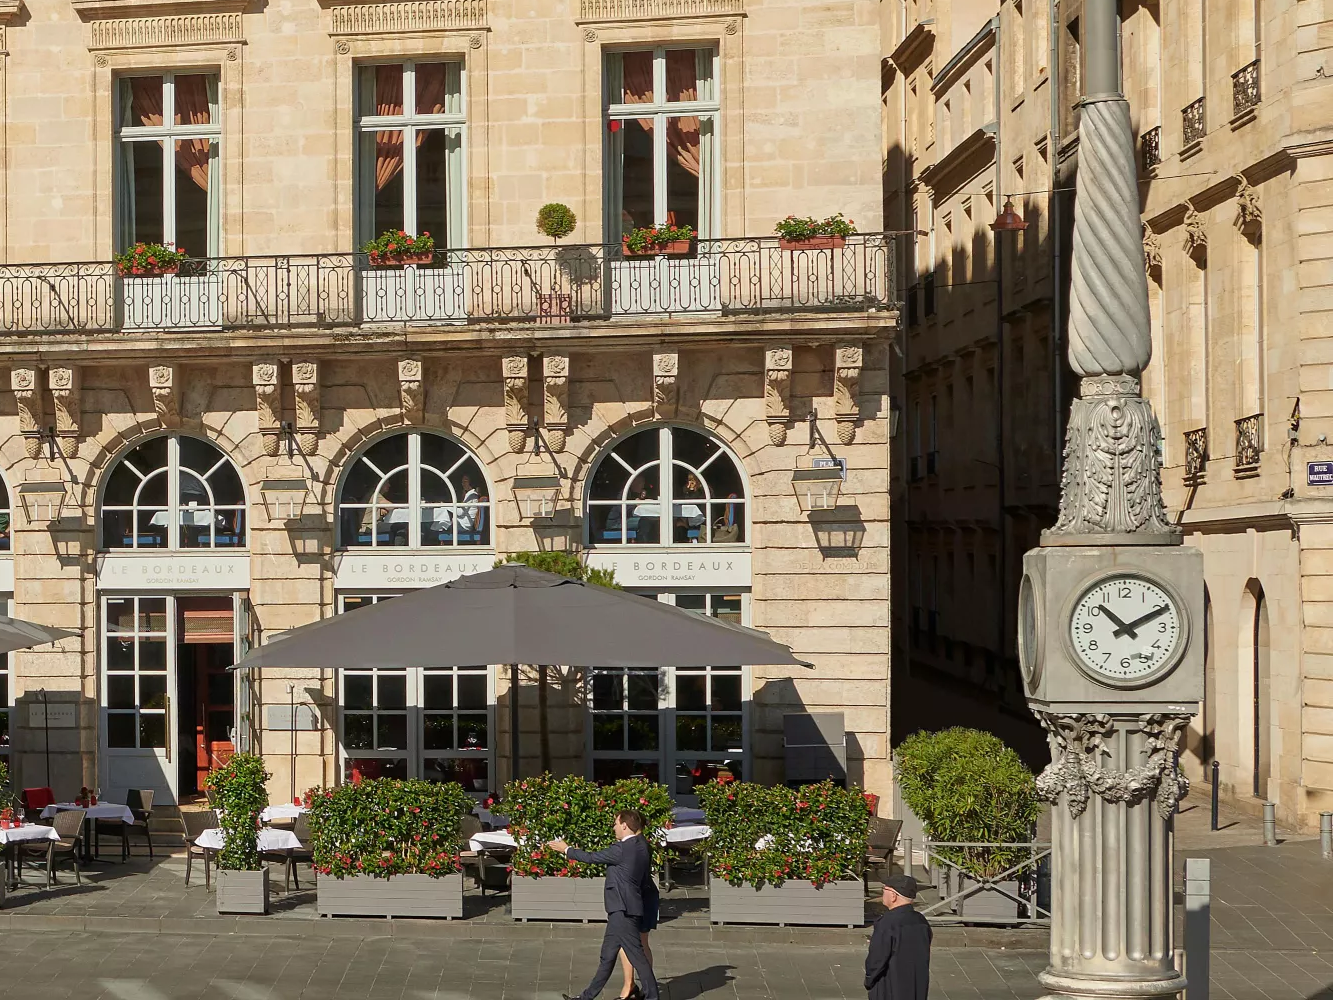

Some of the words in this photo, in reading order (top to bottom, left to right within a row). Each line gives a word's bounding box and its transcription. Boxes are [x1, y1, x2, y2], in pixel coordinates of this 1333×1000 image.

[112, 566, 128, 574] LE
[142, 565, 234, 574] BORDEAUX
[351, 564, 367, 573] LE
[383, 564, 478, 572] BORDEAUX
[633, 562, 733, 571] BORDEAUX
[1103, 592, 1110, 603] 11
[1118, 587, 1132, 598] 12
[1087, 605, 1101, 617] 10
[1083, 623, 1093, 633] 9
[1158, 622, 1167, 633] 3
[1088, 639, 1098, 650] 8
[1151, 639, 1162, 650] 4
[1102, 653, 1112, 663] 7
[1120, 657, 1131, 668] 6
